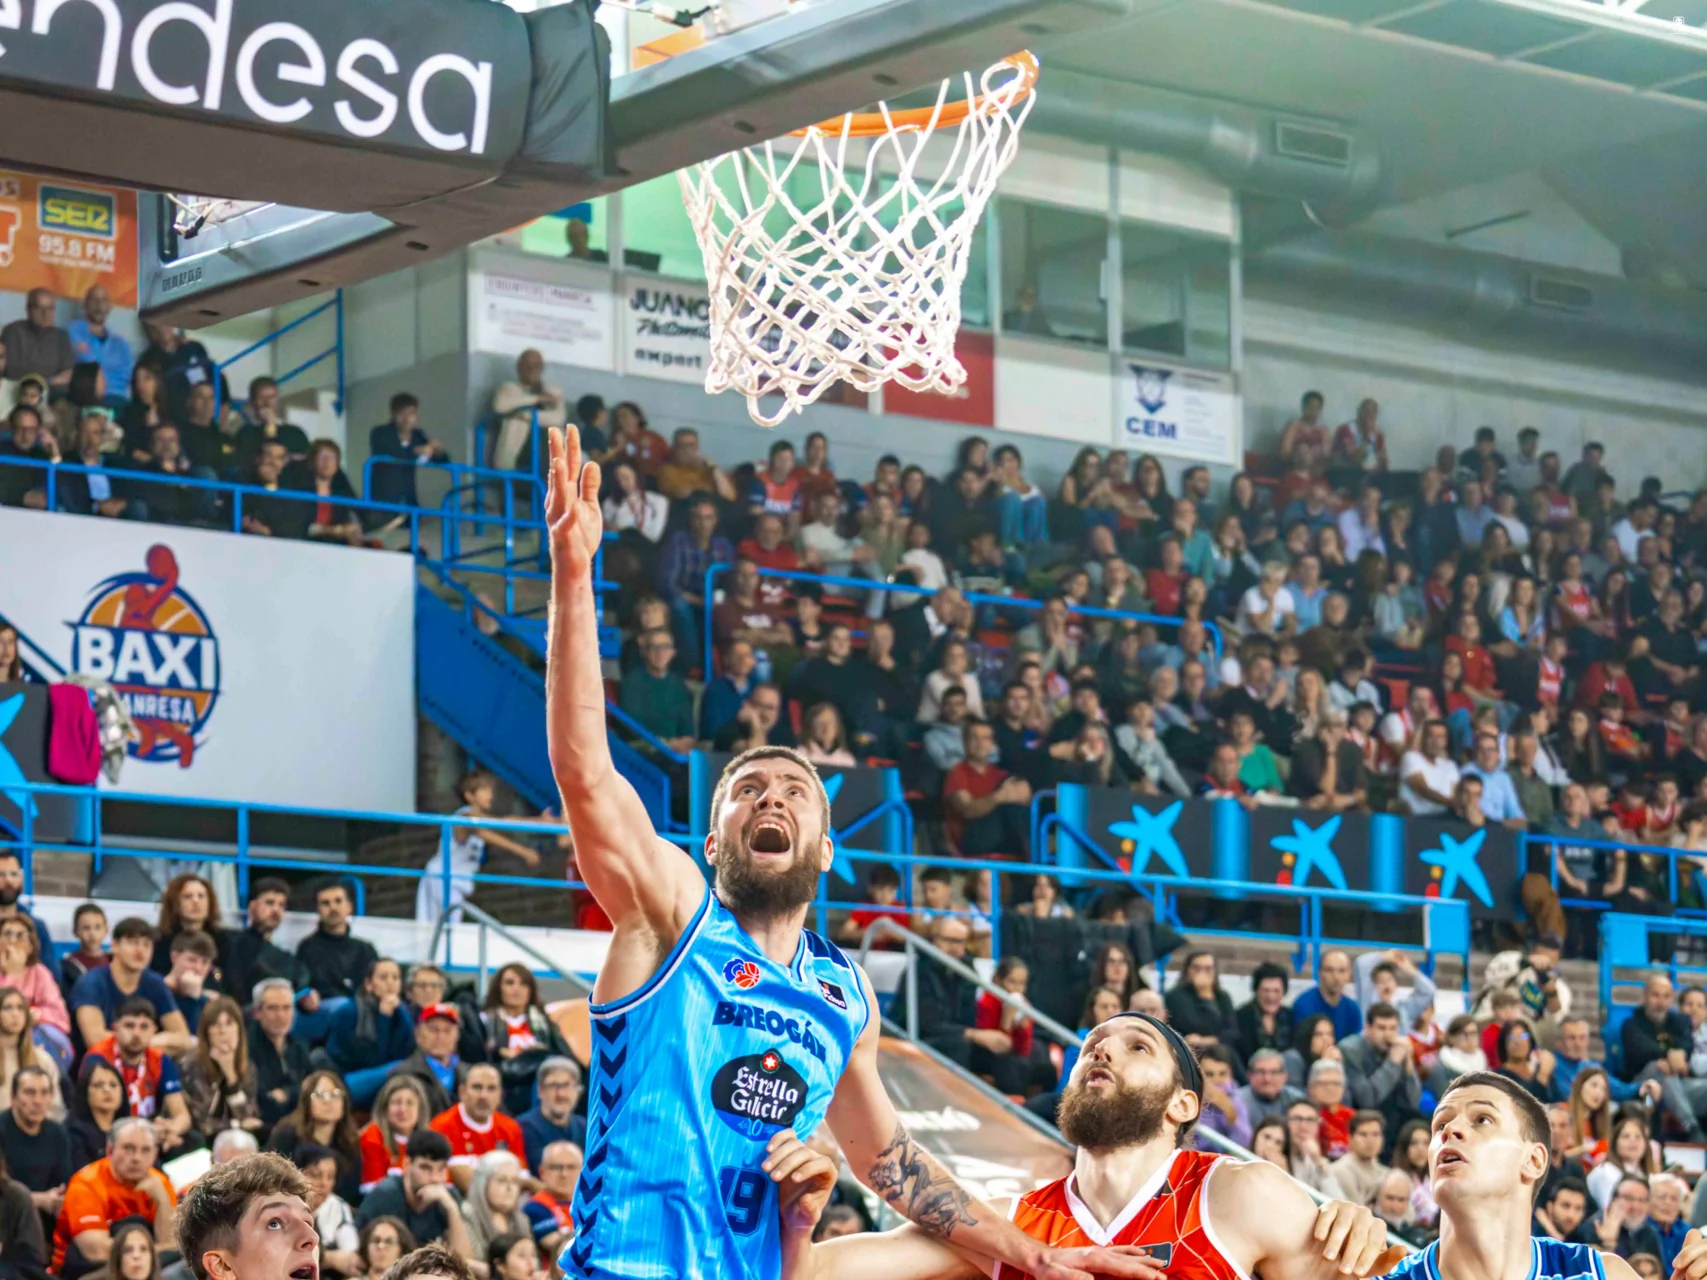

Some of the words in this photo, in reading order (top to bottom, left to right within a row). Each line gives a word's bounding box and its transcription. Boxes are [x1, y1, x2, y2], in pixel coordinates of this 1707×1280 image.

[0, 0, 493, 154] ndesa
[86, 241, 115, 264] FM
[1125, 416, 1178, 440] CEM
[78, 625, 216, 689] BAXI
[121, 692, 196, 723] ANRESA
[731, 1066, 799, 1104] Estrella
